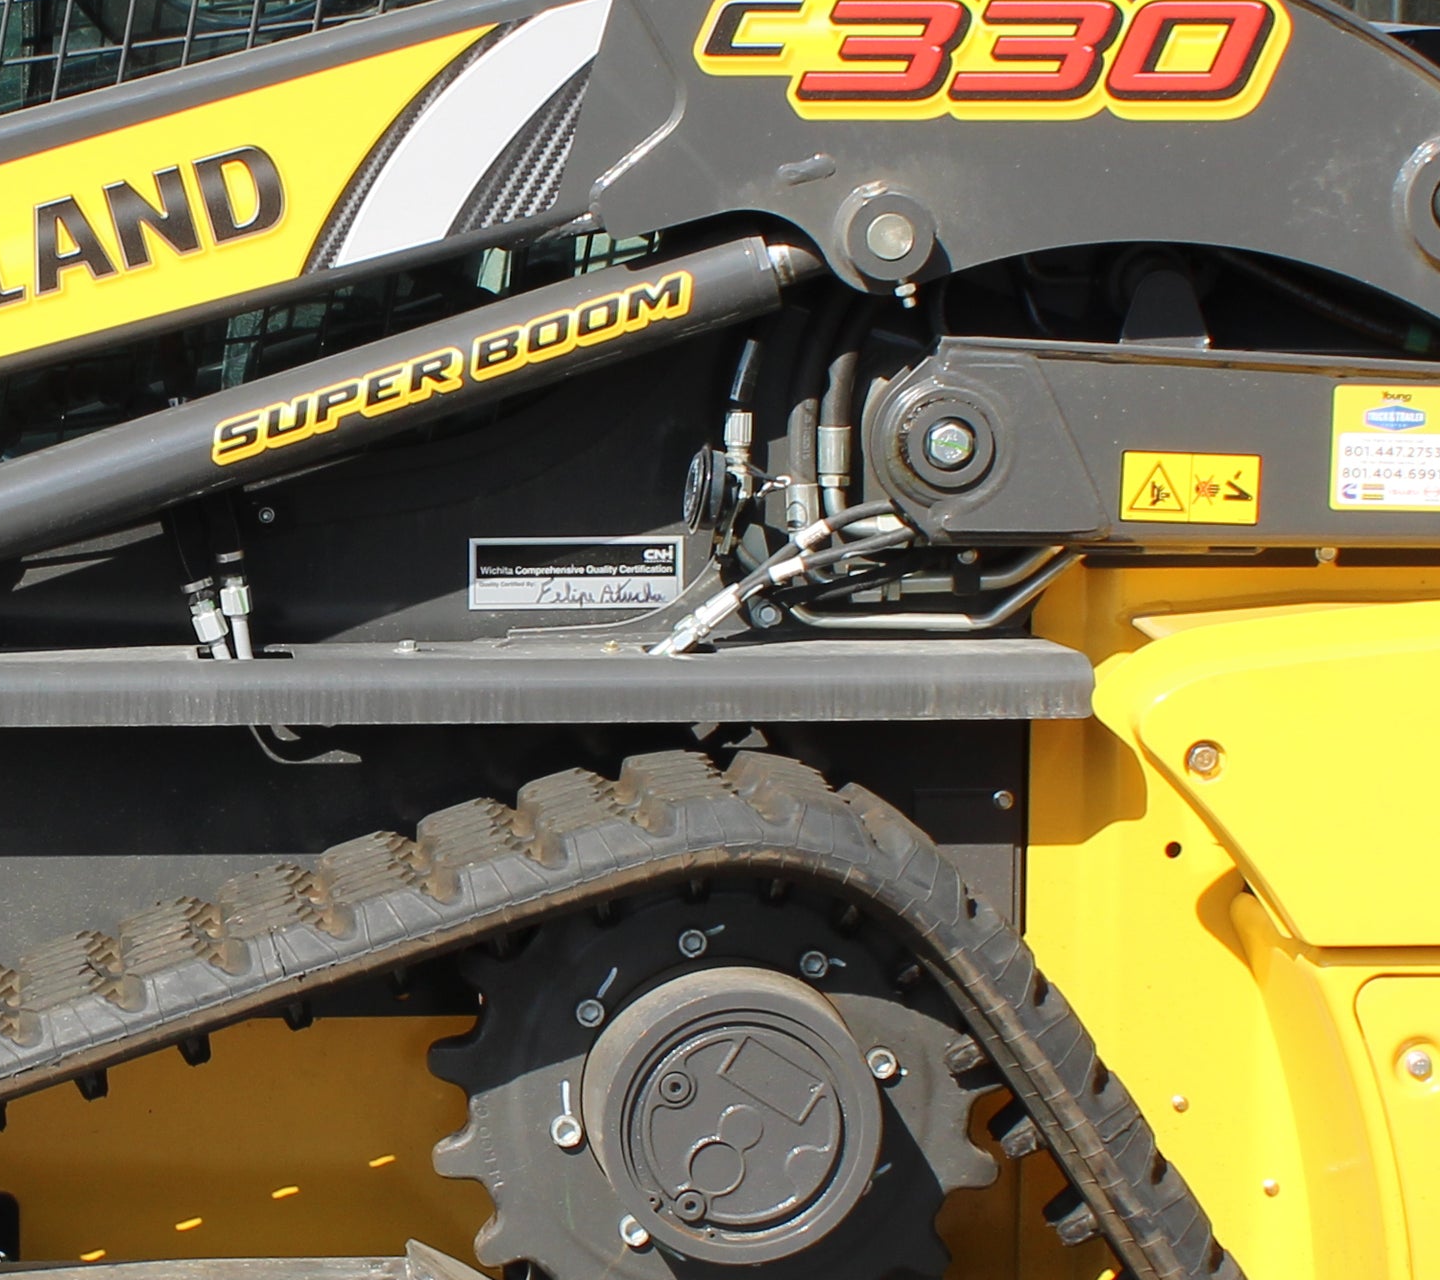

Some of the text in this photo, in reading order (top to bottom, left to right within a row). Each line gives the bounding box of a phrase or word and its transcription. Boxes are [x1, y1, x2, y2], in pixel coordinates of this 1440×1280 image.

[216, 275, 686, 458] SUPER BOOM
[1382, 391, 1412, 402] Young
[480, 564, 673, 576] Wichita Comprehensive Quality Certification
